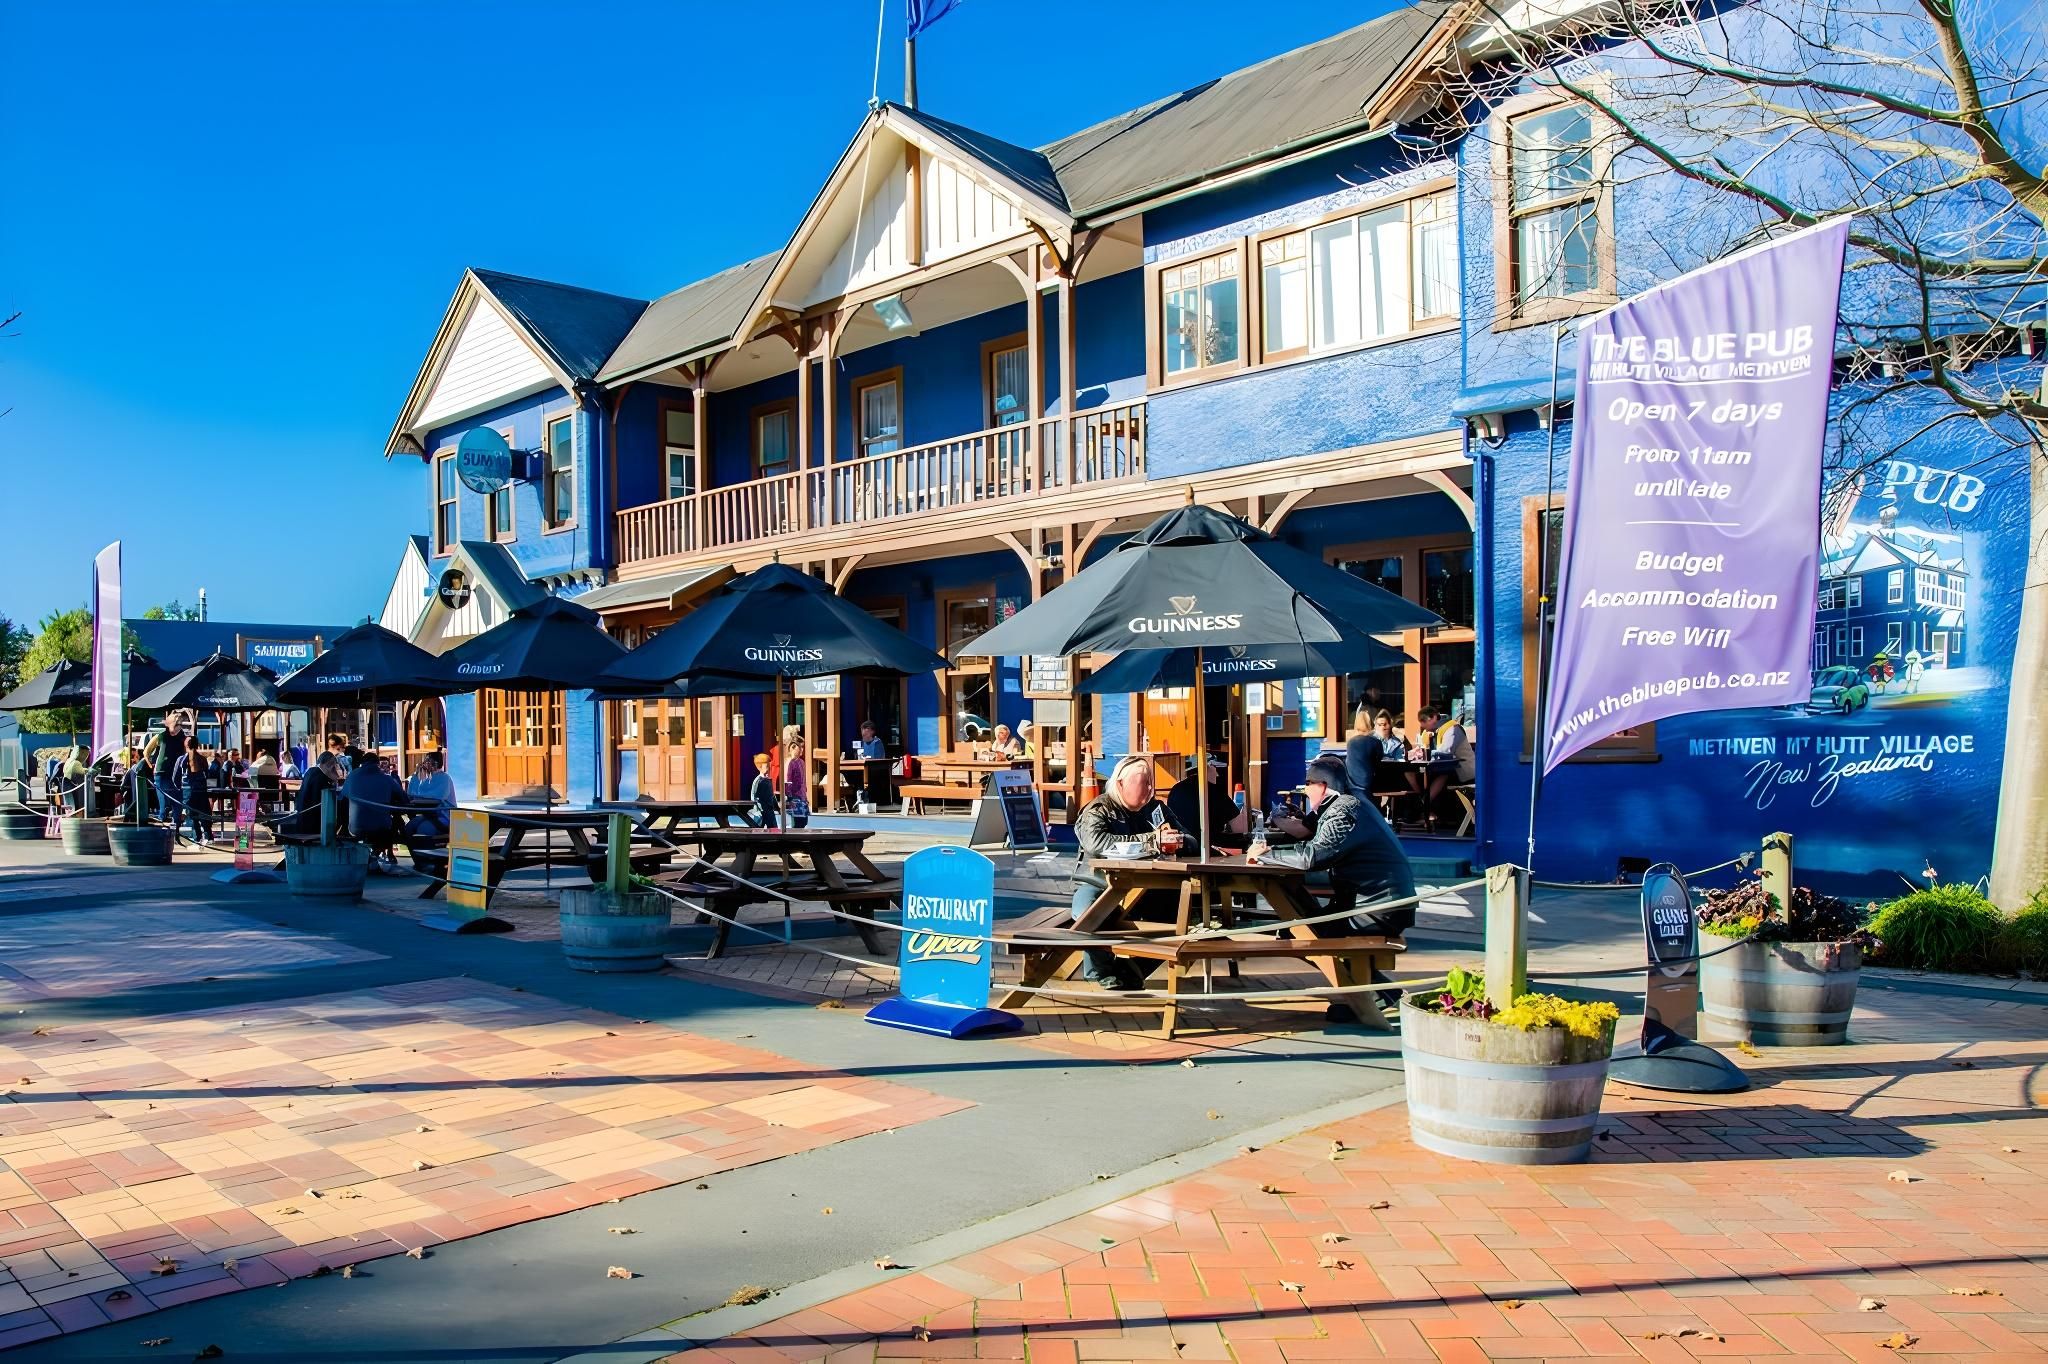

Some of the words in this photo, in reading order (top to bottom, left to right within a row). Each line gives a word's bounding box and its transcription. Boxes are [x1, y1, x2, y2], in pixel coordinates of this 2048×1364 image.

[1592, 333, 1647, 363] THE
[1653, 333, 1737, 363] BLUE
[1745, 325, 1814, 359] PUB
[1608, 397, 1677, 425] Open
[1686, 401, 1706, 421] 7
[1711, 398, 1784, 427] days
[1624, 444, 1680, 464] From
[1690, 446, 1752, 465] 11am
[1634, 478, 1683, 497] until
[1686, 481, 1732, 499] late
[1880, 459, 1986, 513] PUB
[1635, 550, 1725, 577] Budget
[1580, 588, 1778, 610] Accommodation
[1128, 614, 1244, 634] GUINNESS
[1621, 626, 1677, 646] Free
[744, 647, 823, 662] GUINNESS
[1202, 659, 1278, 674] GUINNESS
[1689, 735, 1777, 756] METHVEN
[1816, 735, 1870, 755] HUTT
[1880, 734, 1975, 754] VILLAGE
[1744, 759, 1813, 810] New
[1810, 750, 1934, 808] Zealand
[907, 894, 988, 926] RESTAURANT
[907, 928, 984, 959] Open
